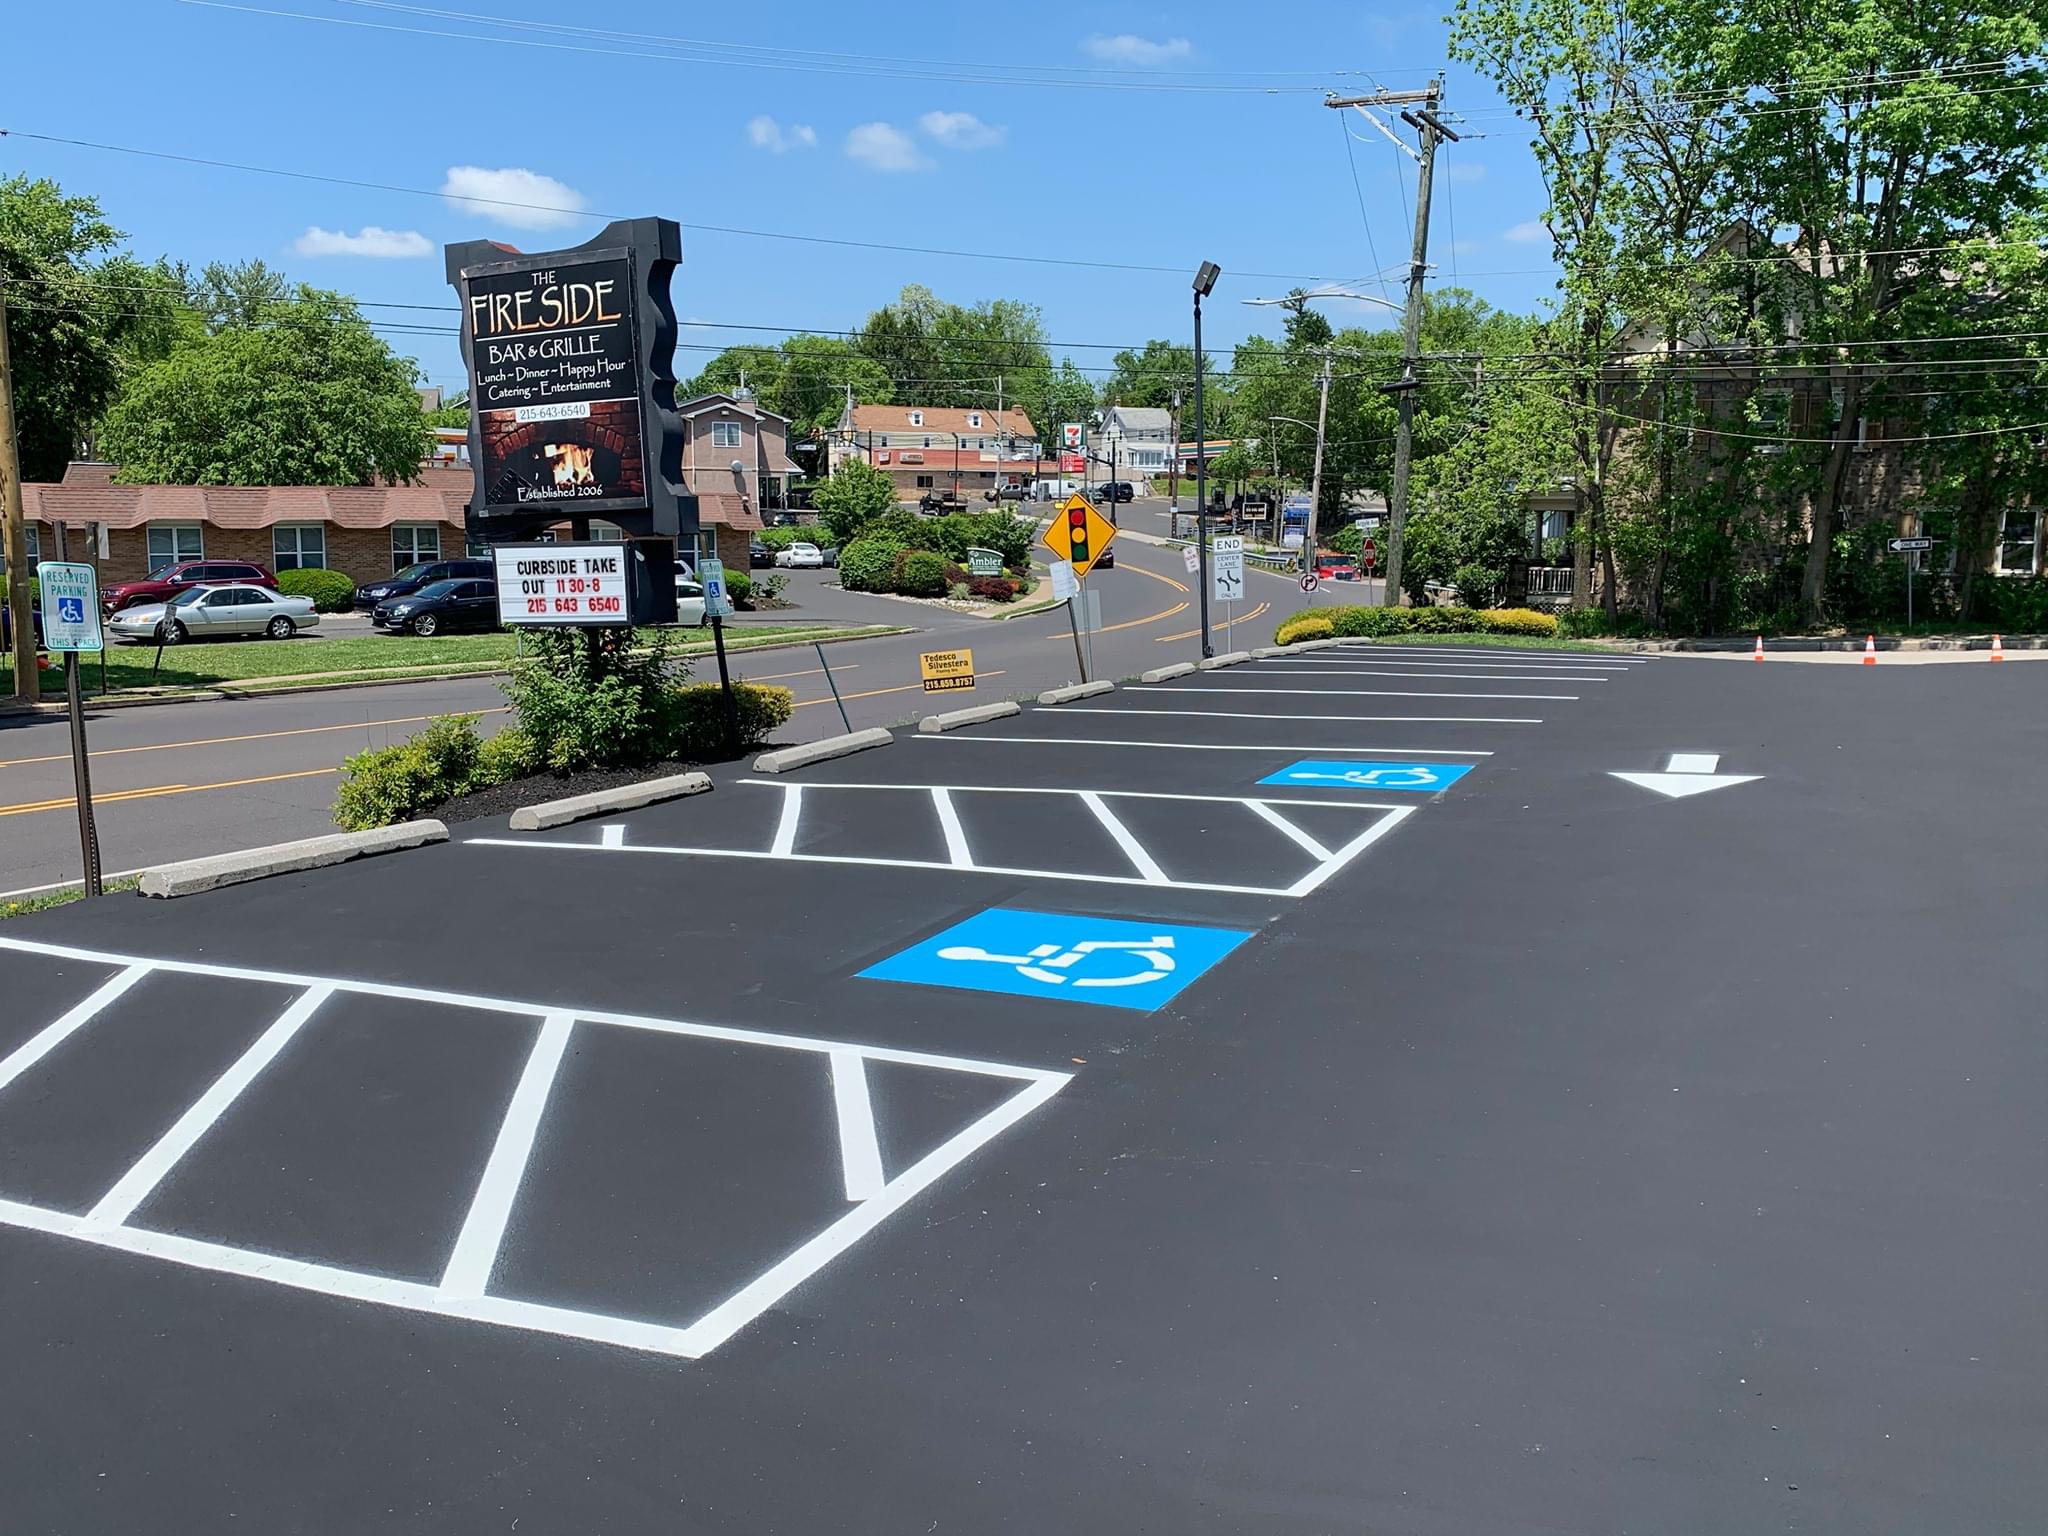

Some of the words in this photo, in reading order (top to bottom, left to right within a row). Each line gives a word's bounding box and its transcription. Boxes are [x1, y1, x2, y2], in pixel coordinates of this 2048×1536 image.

[531, 271, 556, 286] THE
[471, 279, 622, 336] FIRESIDE
[489, 342, 526, 365] BAR
[528, 345, 538, 357] &
[539, 334, 605, 359] GRILLE
[477, 369, 507, 386] Lunch
[515, 366, 550, 382] Dinner
[559, 362, 595, 380] Happy
[597, 358, 626, 373] Hour
[488, 385, 531, 401] Catering
[540, 379, 611, 396] Entertainment
[520, 403, 586, 420] 215-643-6540
[517, 485, 576, 501] Established
[578, 484, 603, 497] 2006
[1216, 540, 1240, 550] END
[517, 559, 577, 576] CURBSIDE
[583, 558, 617, 574] TAKE
[968, 557, 1002, 566] Ambler
[46, 571, 89, 584] RESERVED
[51, 585, 87, 597] PARKING
[522, 580, 545, 594] OUT
[527, 599, 547, 613] 215
[555, 598, 578, 612] 643
[588, 597, 620, 612] 6540
[924, 653, 956, 663] Tedesco
[928, 660, 969, 670] Silvestera
